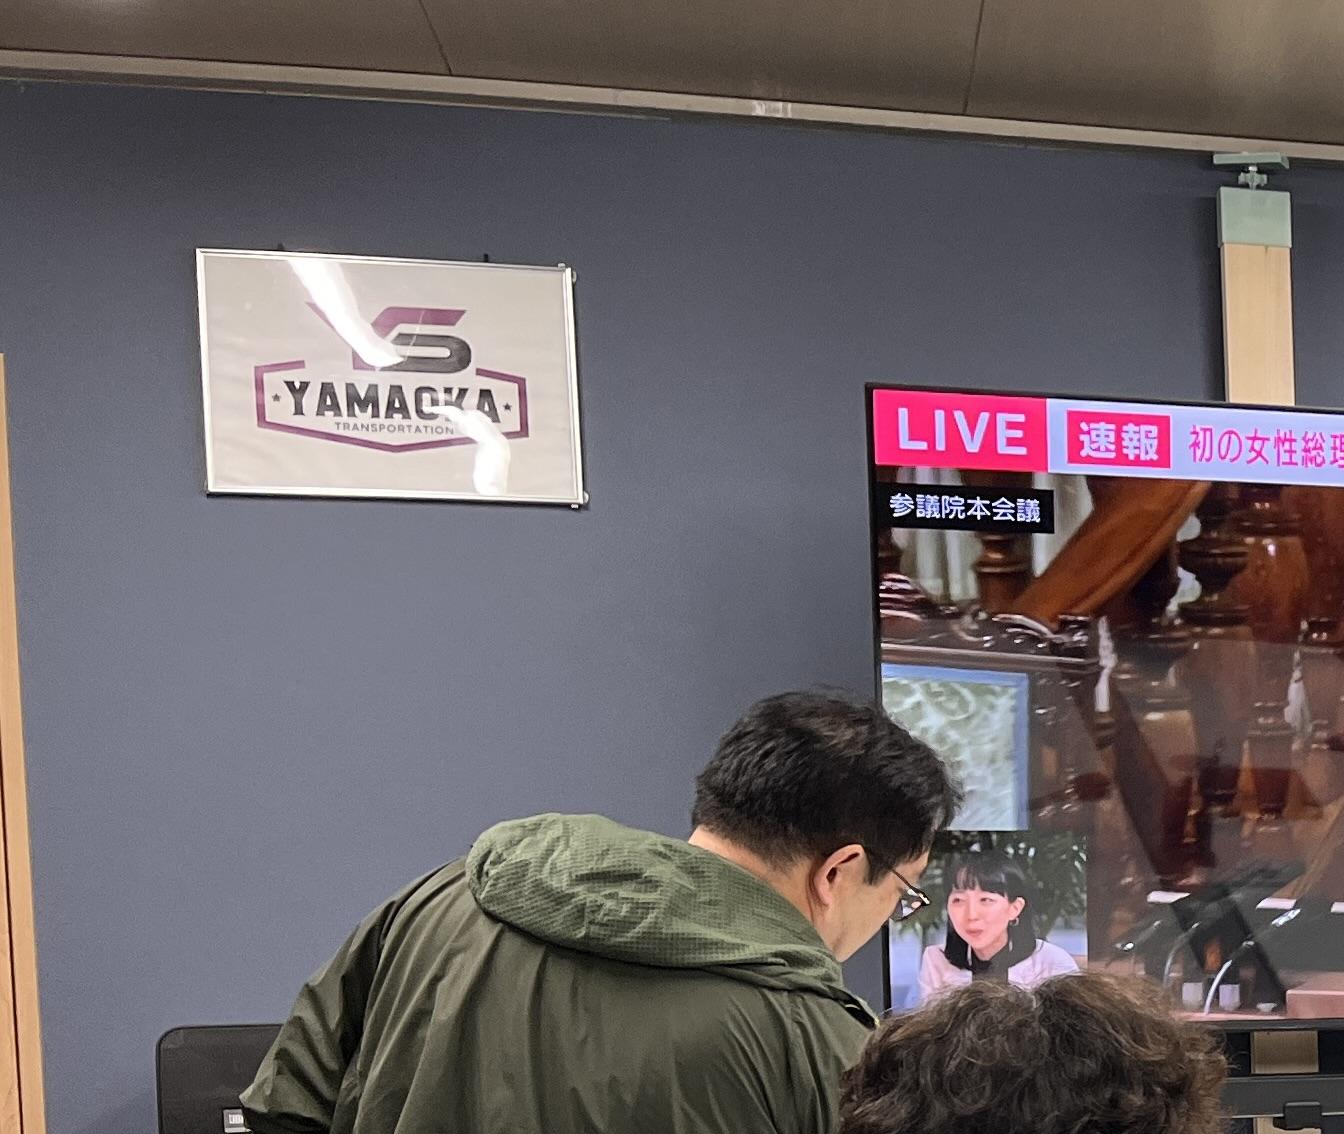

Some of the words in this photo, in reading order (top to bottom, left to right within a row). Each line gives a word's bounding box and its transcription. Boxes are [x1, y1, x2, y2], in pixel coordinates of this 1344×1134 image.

[283, 379, 502, 424] YAMAOKA
[333, 420, 455, 436] TRANSPORTATION
[897, 406, 1029, 456] LIVE
[1078, 420, 1160, 463] 速報
[888, 492, 1042, 525] 参議院本会議
